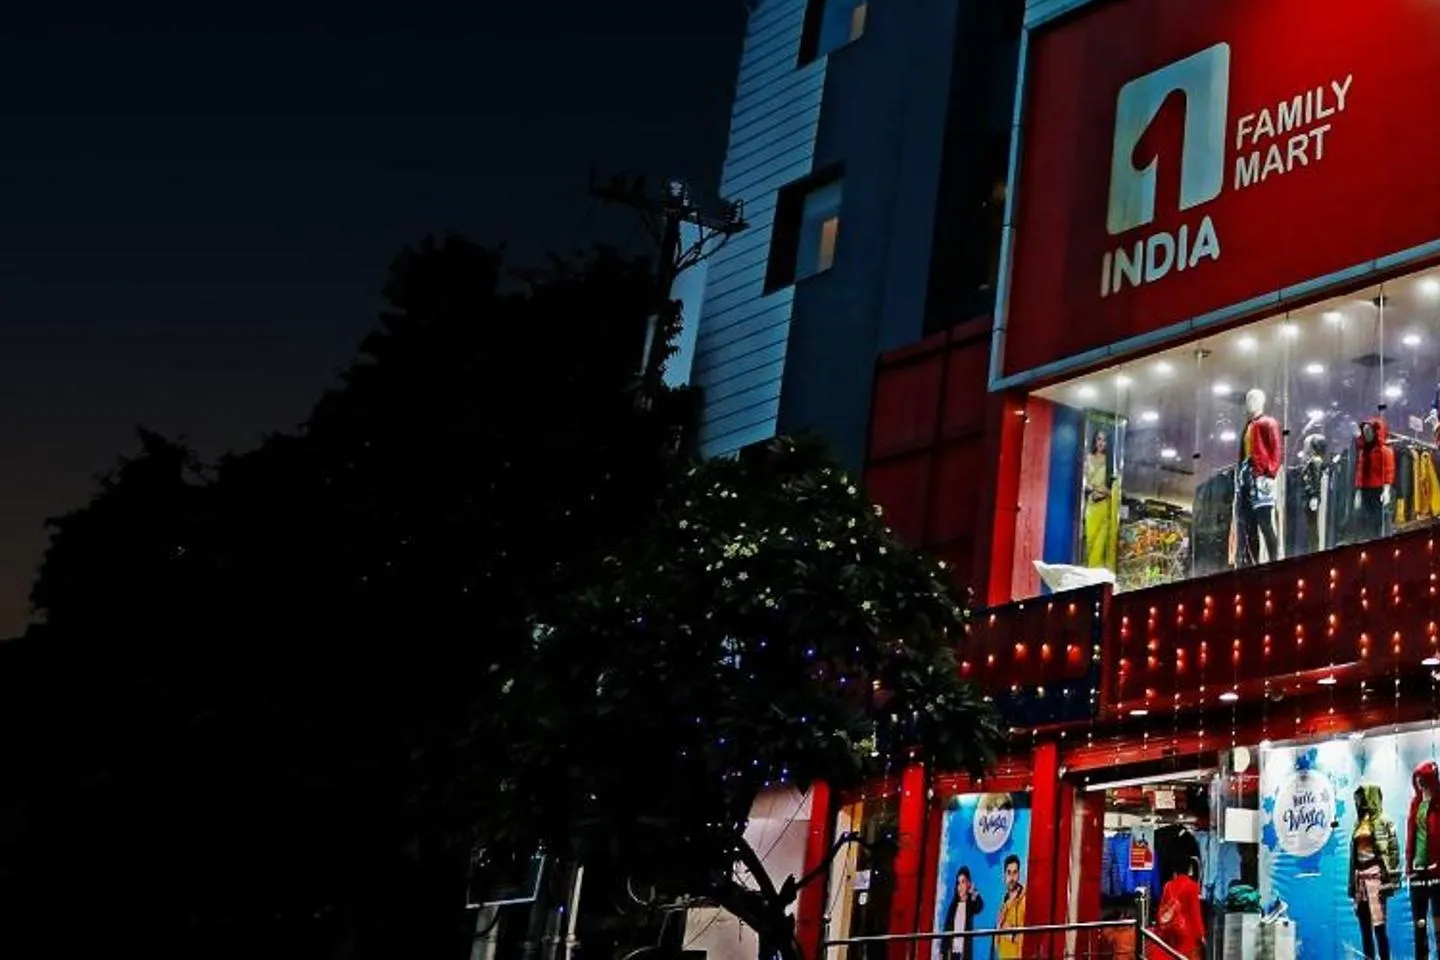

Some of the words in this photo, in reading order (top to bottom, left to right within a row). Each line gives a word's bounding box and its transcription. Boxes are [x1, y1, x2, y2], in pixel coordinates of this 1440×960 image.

[1236, 74, 1353, 150] FAMILY
[1234, 124, 1332, 190] MART
[1101, 215, 1221, 297] INDIA
